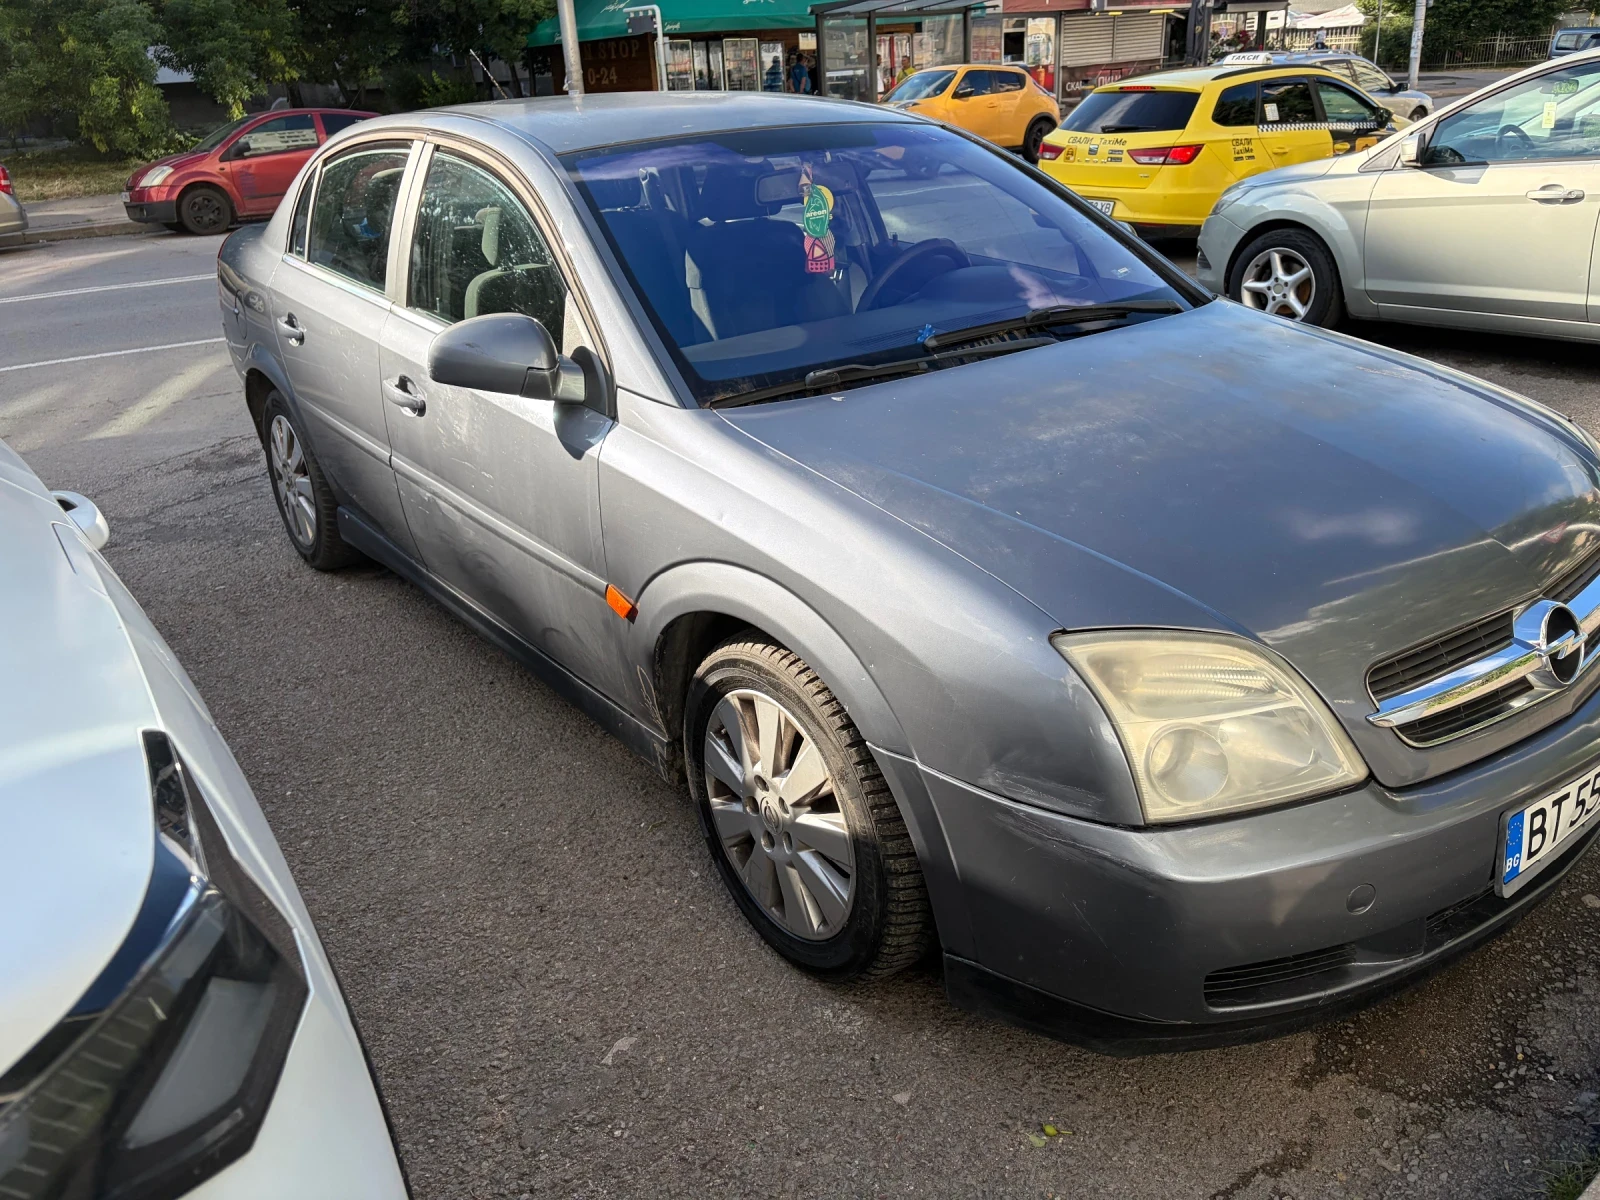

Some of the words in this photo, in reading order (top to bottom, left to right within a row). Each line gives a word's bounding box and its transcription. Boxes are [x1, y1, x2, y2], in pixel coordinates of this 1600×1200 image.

[598, 39, 640, 59] STOP
[587, 66, 618, 86] 0-24
[1066, 81, 1083, 92] СКА
[1067, 136, 1094, 145] СВАЛИ
[1100, 137, 1127, 146] TaxiMe
[1231, 137, 1253, 147] СВАЛИ
[1232, 146, 1254, 155] TaxiMe
[805, 209, 827, 218] areon
[1505, 853, 1521, 873] BG
